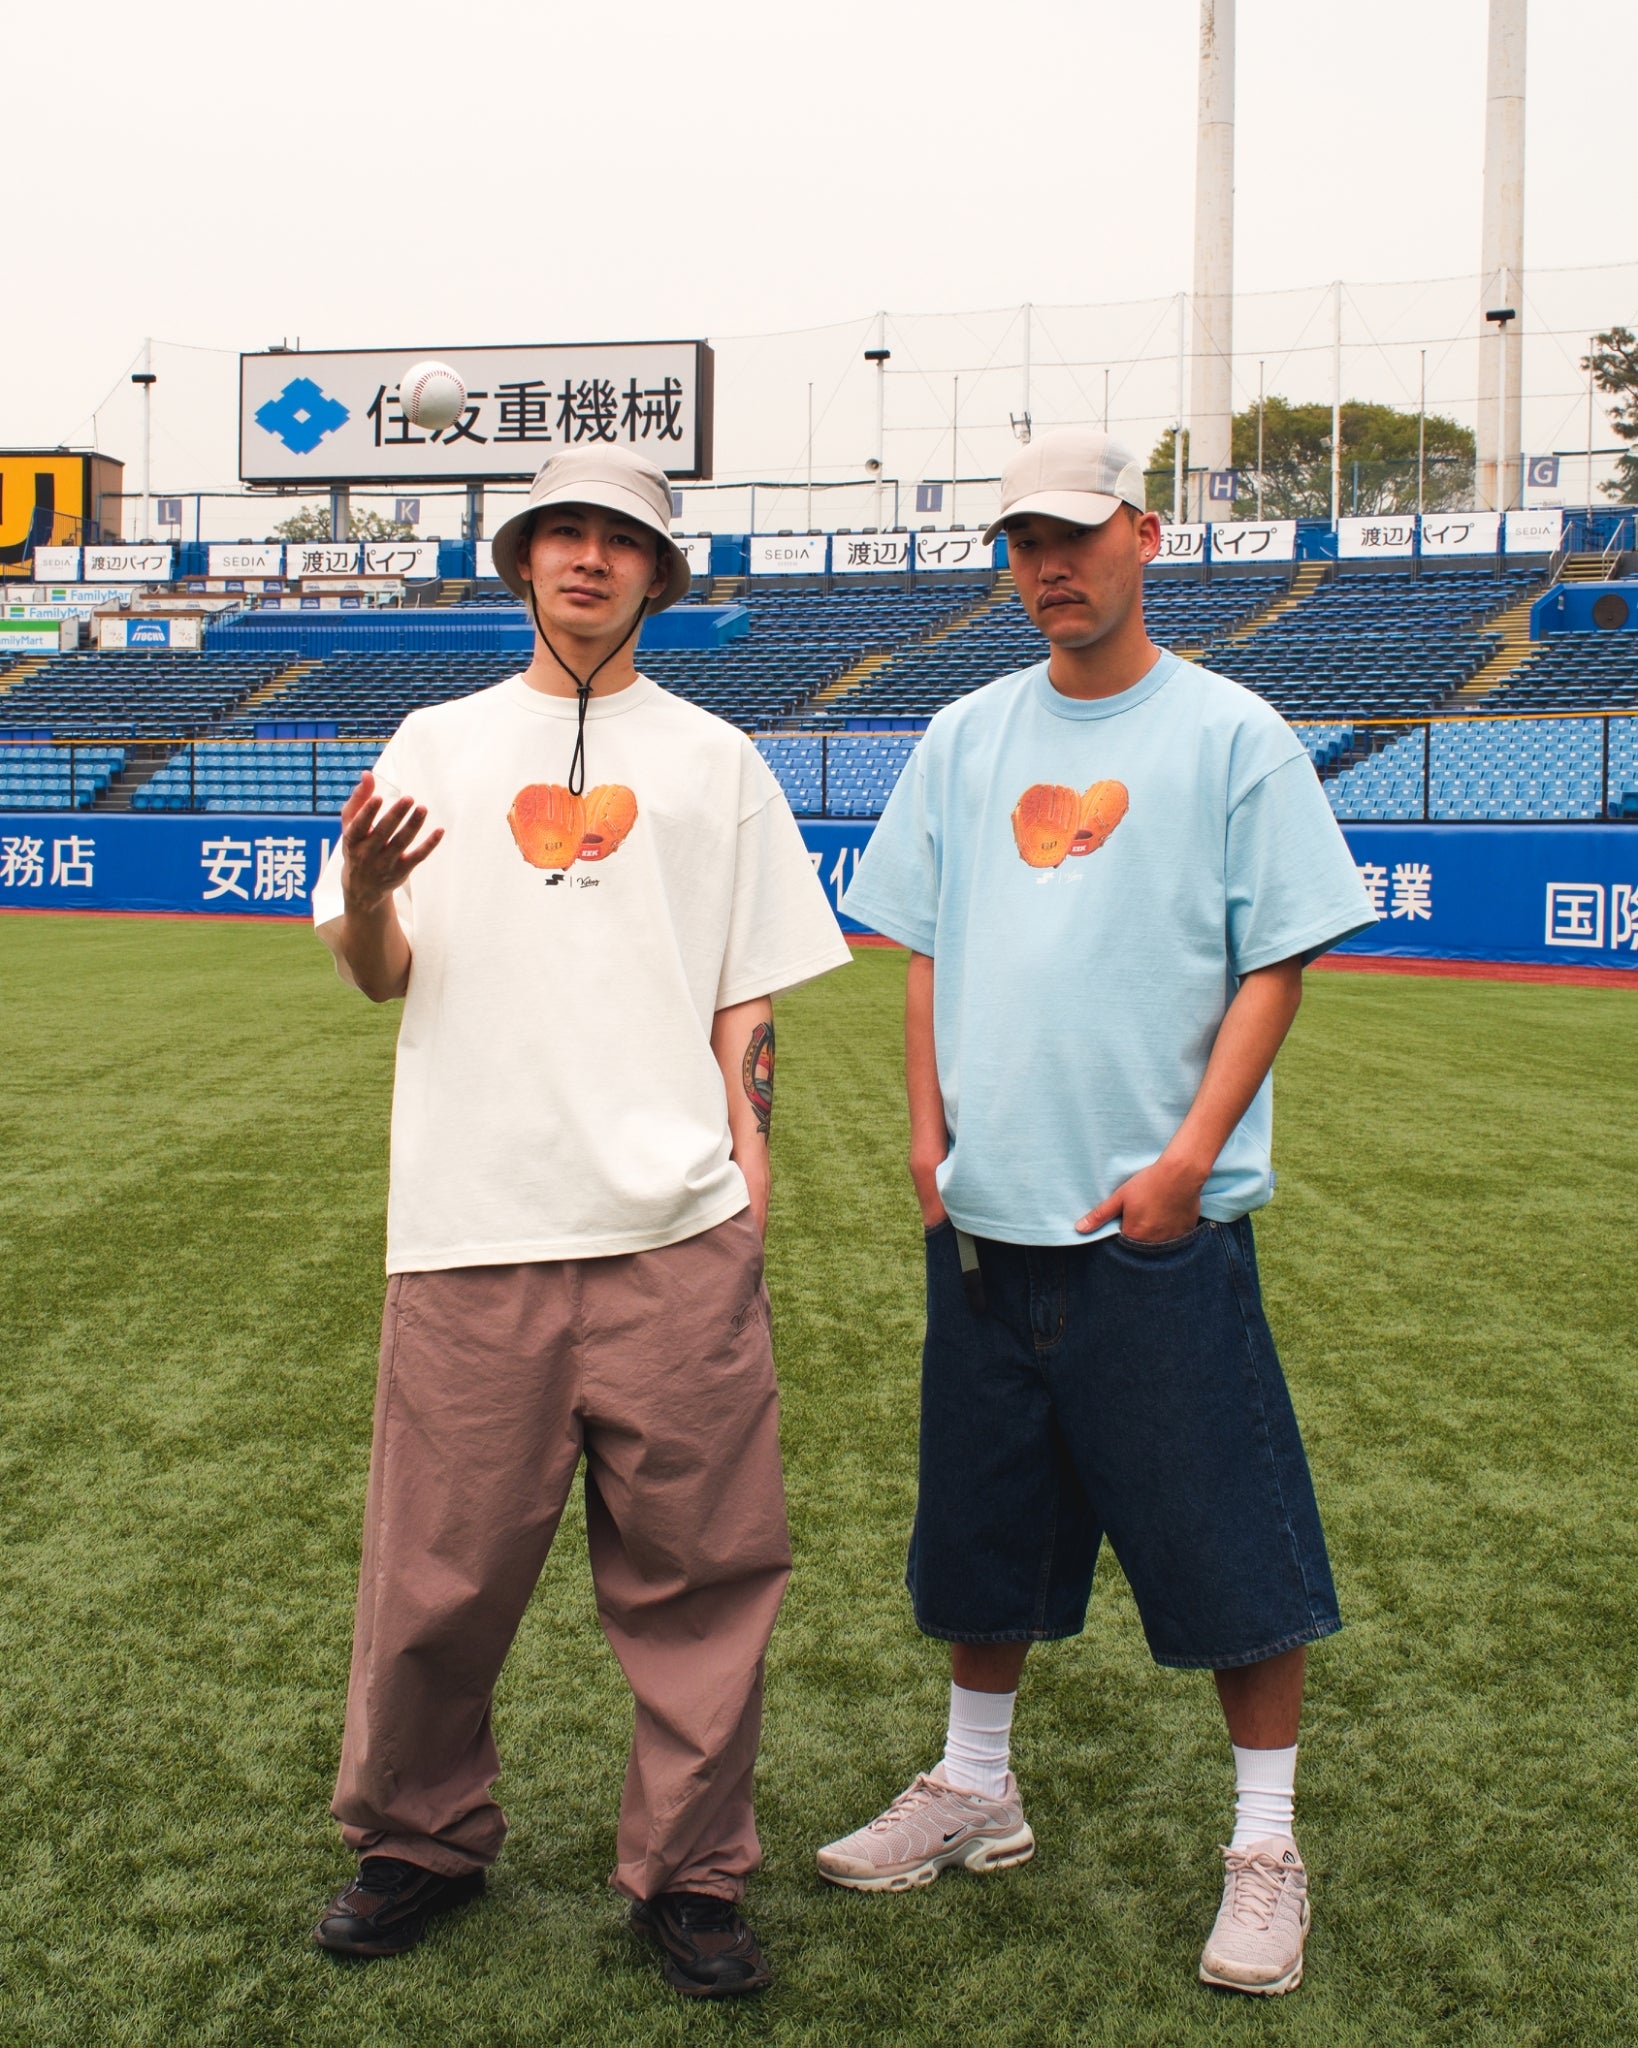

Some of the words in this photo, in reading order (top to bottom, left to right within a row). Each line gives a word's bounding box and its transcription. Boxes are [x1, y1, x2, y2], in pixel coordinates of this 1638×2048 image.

[1533, 461, 1553, 484] G
[1213, 475, 1233, 498] H
[926, 488, 932, 509] I
[166, 502, 176, 521] L
[399, 502, 415, 521] K
[1360, 522, 1475, 547] 渡辺パイプ
[1515, 525, 1551, 536] SEDIA
[847, 537, 978, 566] 渡辺パイプ
[1160, 527, 1278, 557] 辺パイプ
[42, 558, 71, 567] SEDIA
[223, 556, 266, 567] SEDIA
[302, 549, 423, 573] 渡辺パイプ
[765, 549, 810, 560] SEDIA
[71, 589, 130, 602] FamilyMar
[29, 607, 90, 619] FamilyMar
[0, 835, 96, 888] 務店
